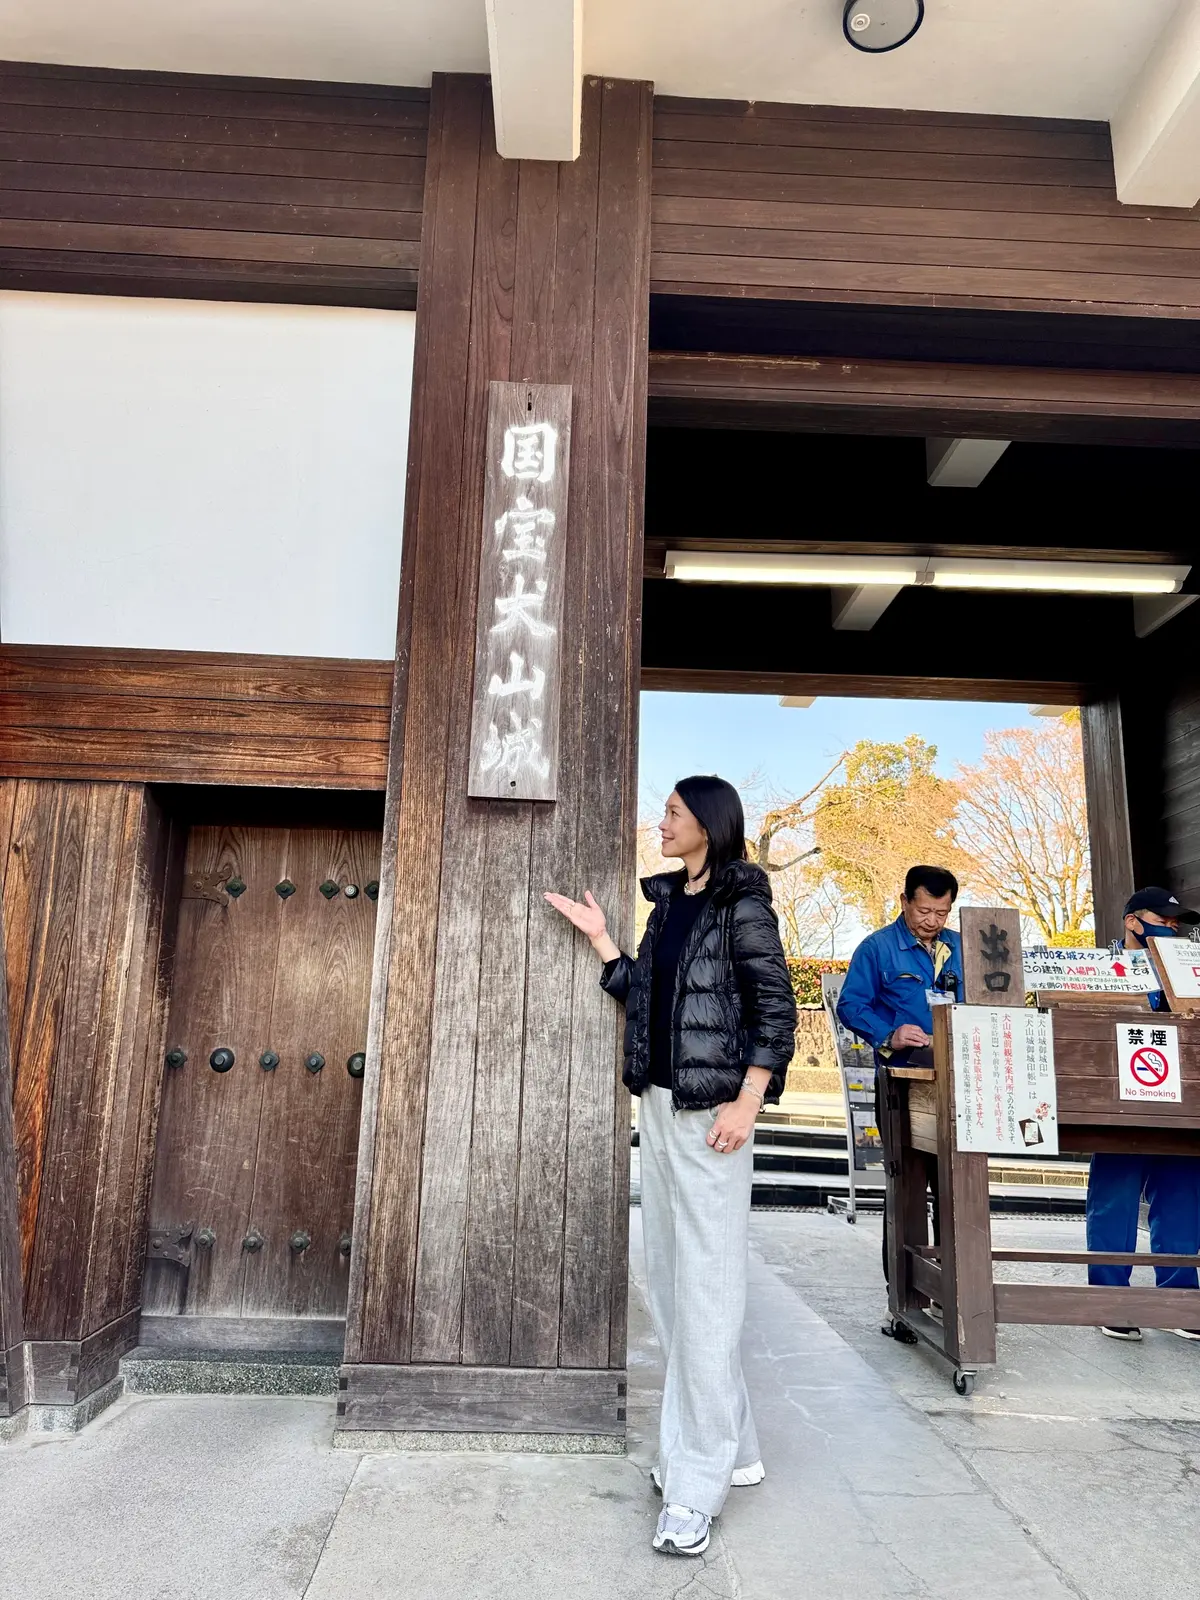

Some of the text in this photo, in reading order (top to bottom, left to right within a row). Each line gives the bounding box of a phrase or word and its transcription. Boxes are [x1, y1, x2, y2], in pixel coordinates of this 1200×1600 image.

[481, 423, 557, 778] 国宝犬山城
[979, 924, 1011, 992] 出口
[1130, 968, 1150, 976] です
[1128, 1028, 1168, 1046] 禁煙
[1125, 1088, 1177, 1099] No Smoking
